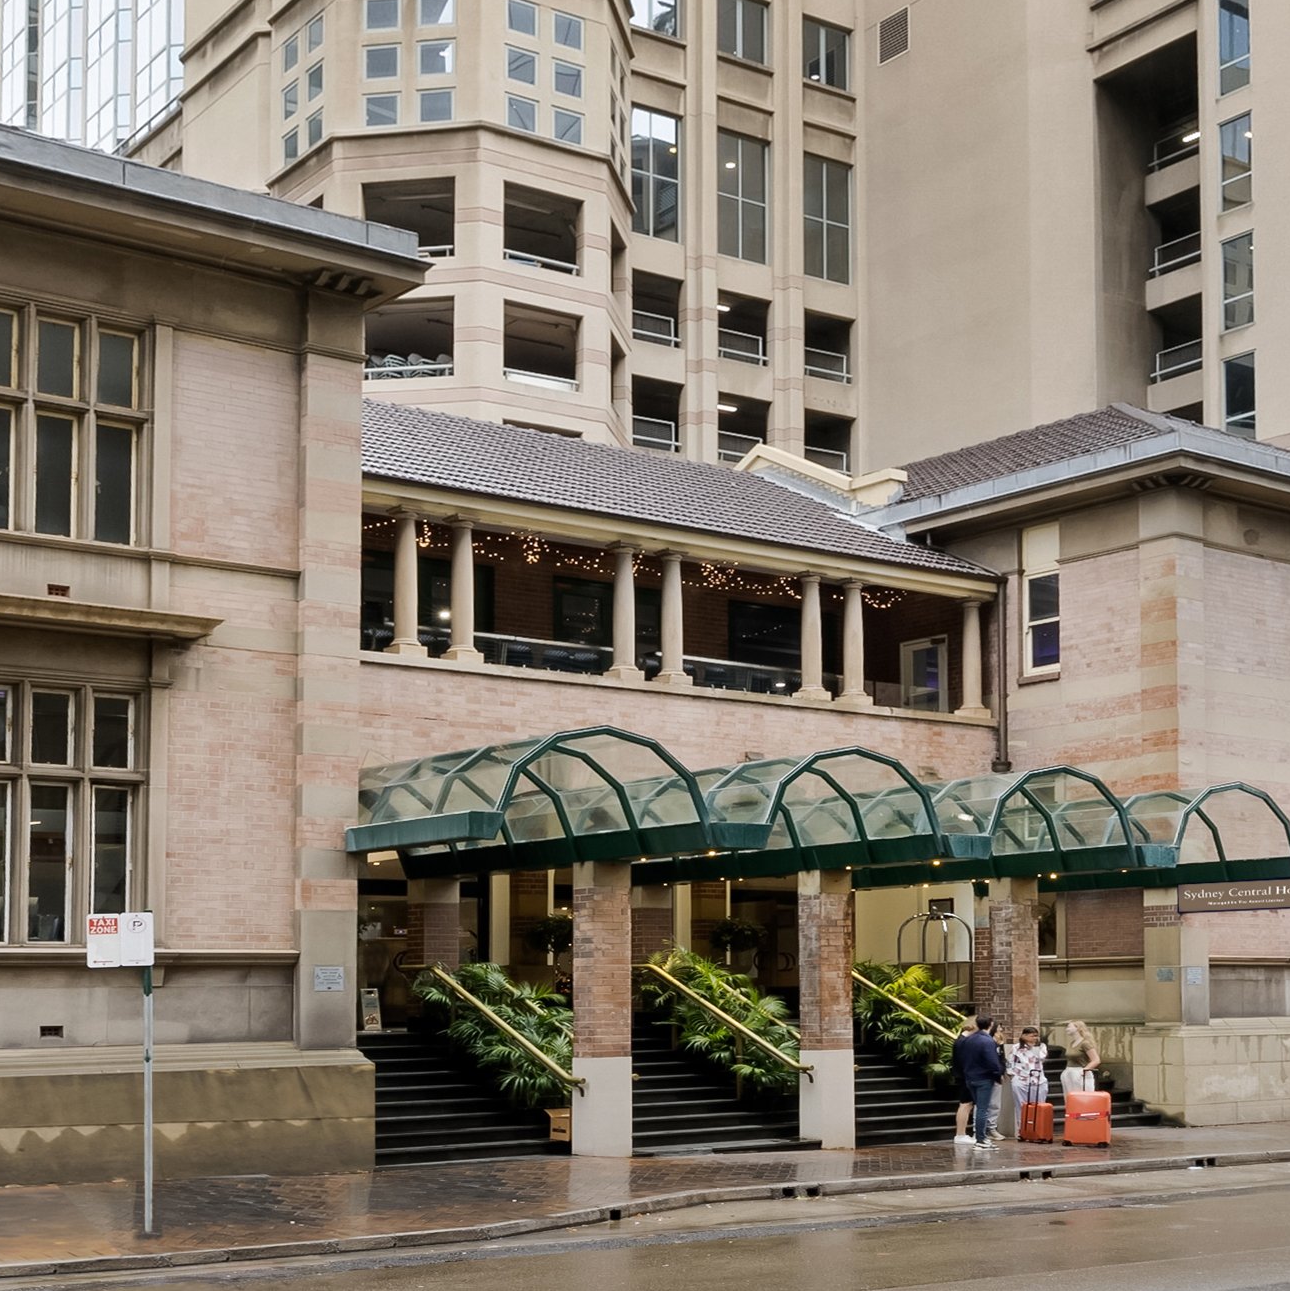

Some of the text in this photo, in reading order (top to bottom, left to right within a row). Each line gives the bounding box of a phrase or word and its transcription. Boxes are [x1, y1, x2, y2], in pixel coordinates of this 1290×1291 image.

[1184, 889, 1224, 900] Sydney
[1228, 886, 1272, 897] Central
[90, 926, 117, 934] ZONE
